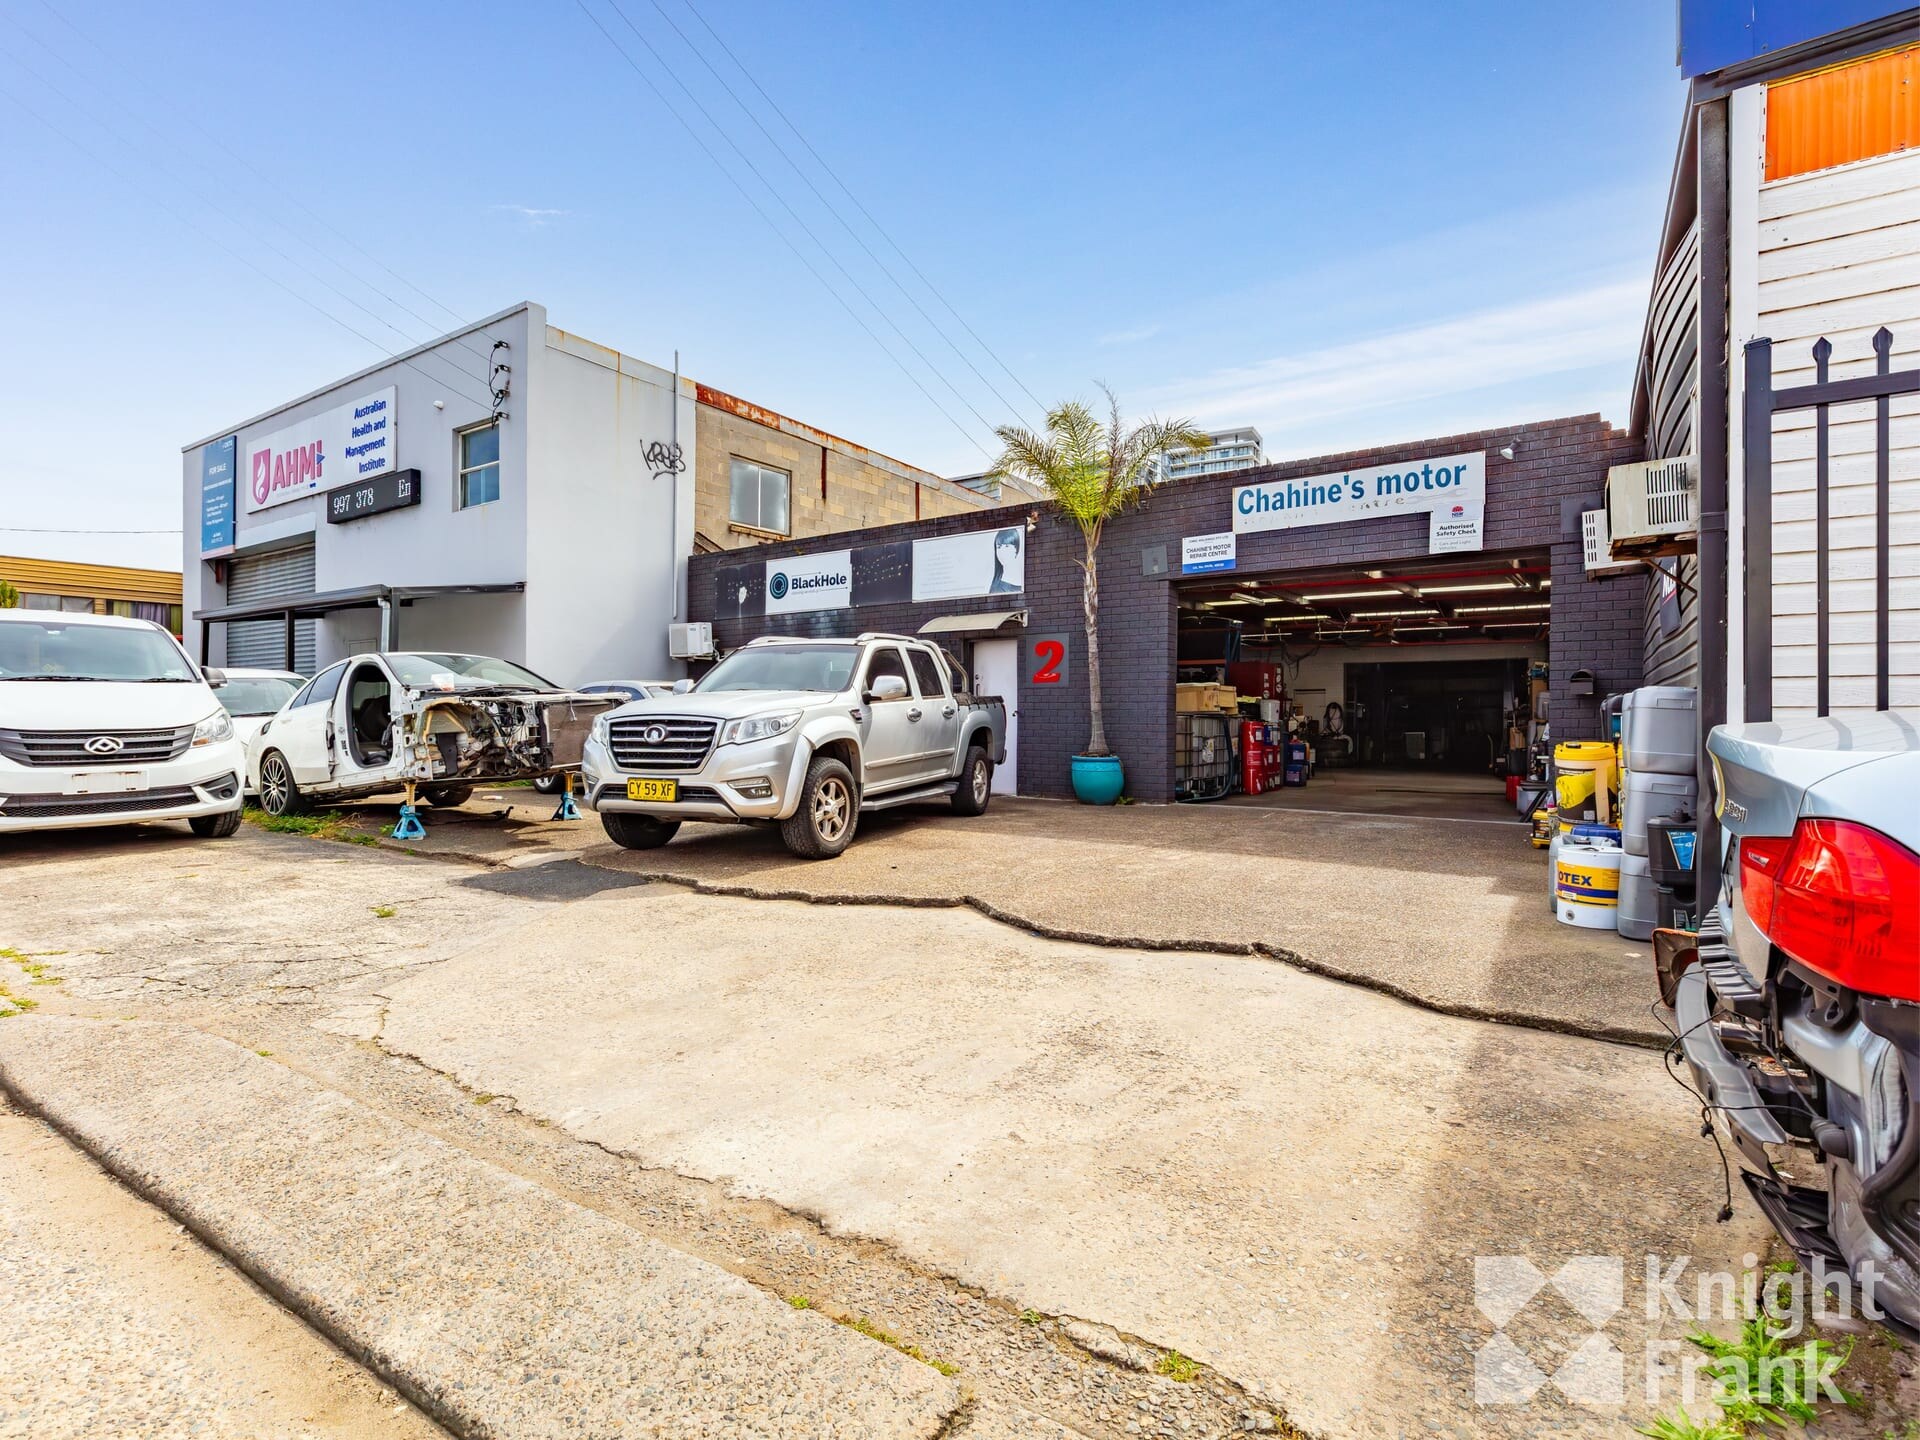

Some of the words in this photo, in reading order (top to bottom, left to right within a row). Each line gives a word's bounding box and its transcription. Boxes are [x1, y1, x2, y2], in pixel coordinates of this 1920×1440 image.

[354, 400, 386, 420] Australian
[352, 421, 373, 438] Health
[373, 416, 386, 431] and
[345, 436, 386, 459] Management
[358, 457, 386, 473] Institute
[1238, 474, 1364, 514] Chahine's
[1377, 463, 1467, 496] motor
[333, 494, 351, 514] 997
[356, 488, 374, 509] 378
[1213, 543, 1231, 551] MOTOR
[791, 573, 848, 590] BlackHole
[1032, 640, 1065, 684] 2
[629, 782, 641, 795] CY
[644, 783, 657, 796] 59
[660, 784, 673, 796] XF
